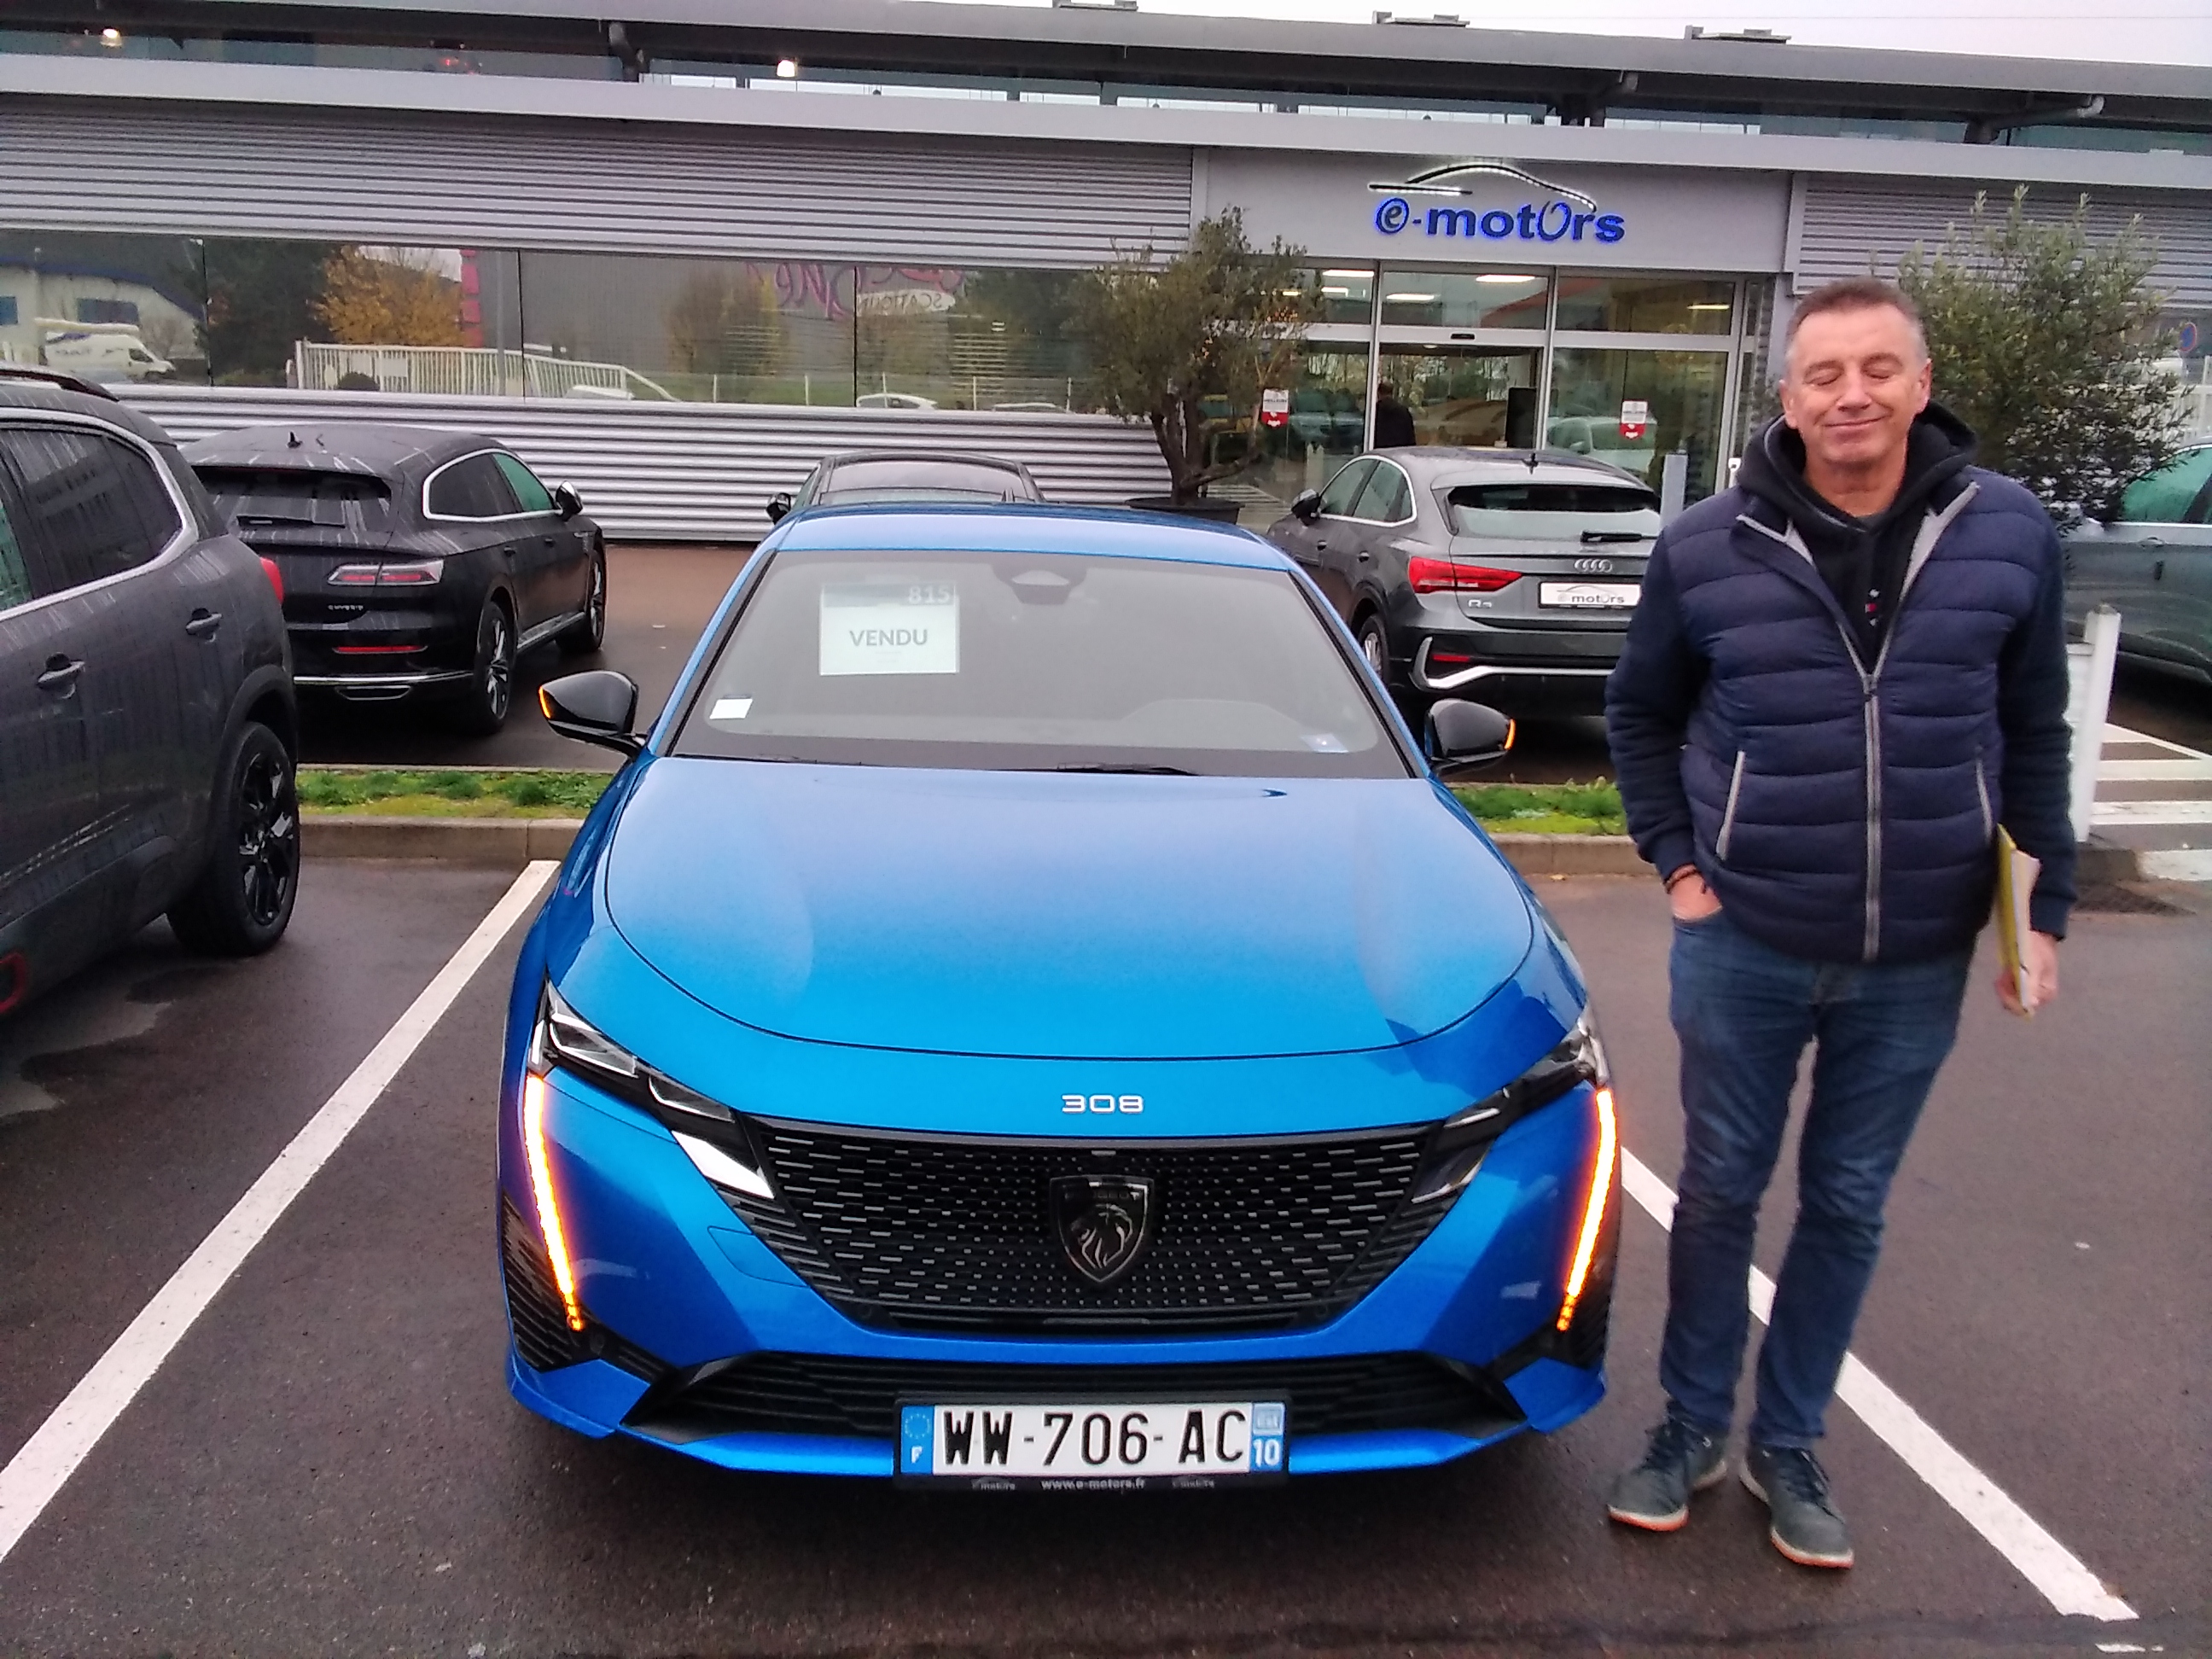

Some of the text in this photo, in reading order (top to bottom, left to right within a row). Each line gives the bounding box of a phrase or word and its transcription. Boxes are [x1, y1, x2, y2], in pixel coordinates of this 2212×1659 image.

[849, 629, 928, 646] VENDU
[1062, 1094, 1144, 1113] 308
[911, 1446, 923, 1464] F
[1253, 1439, 1280, 1467] 10
